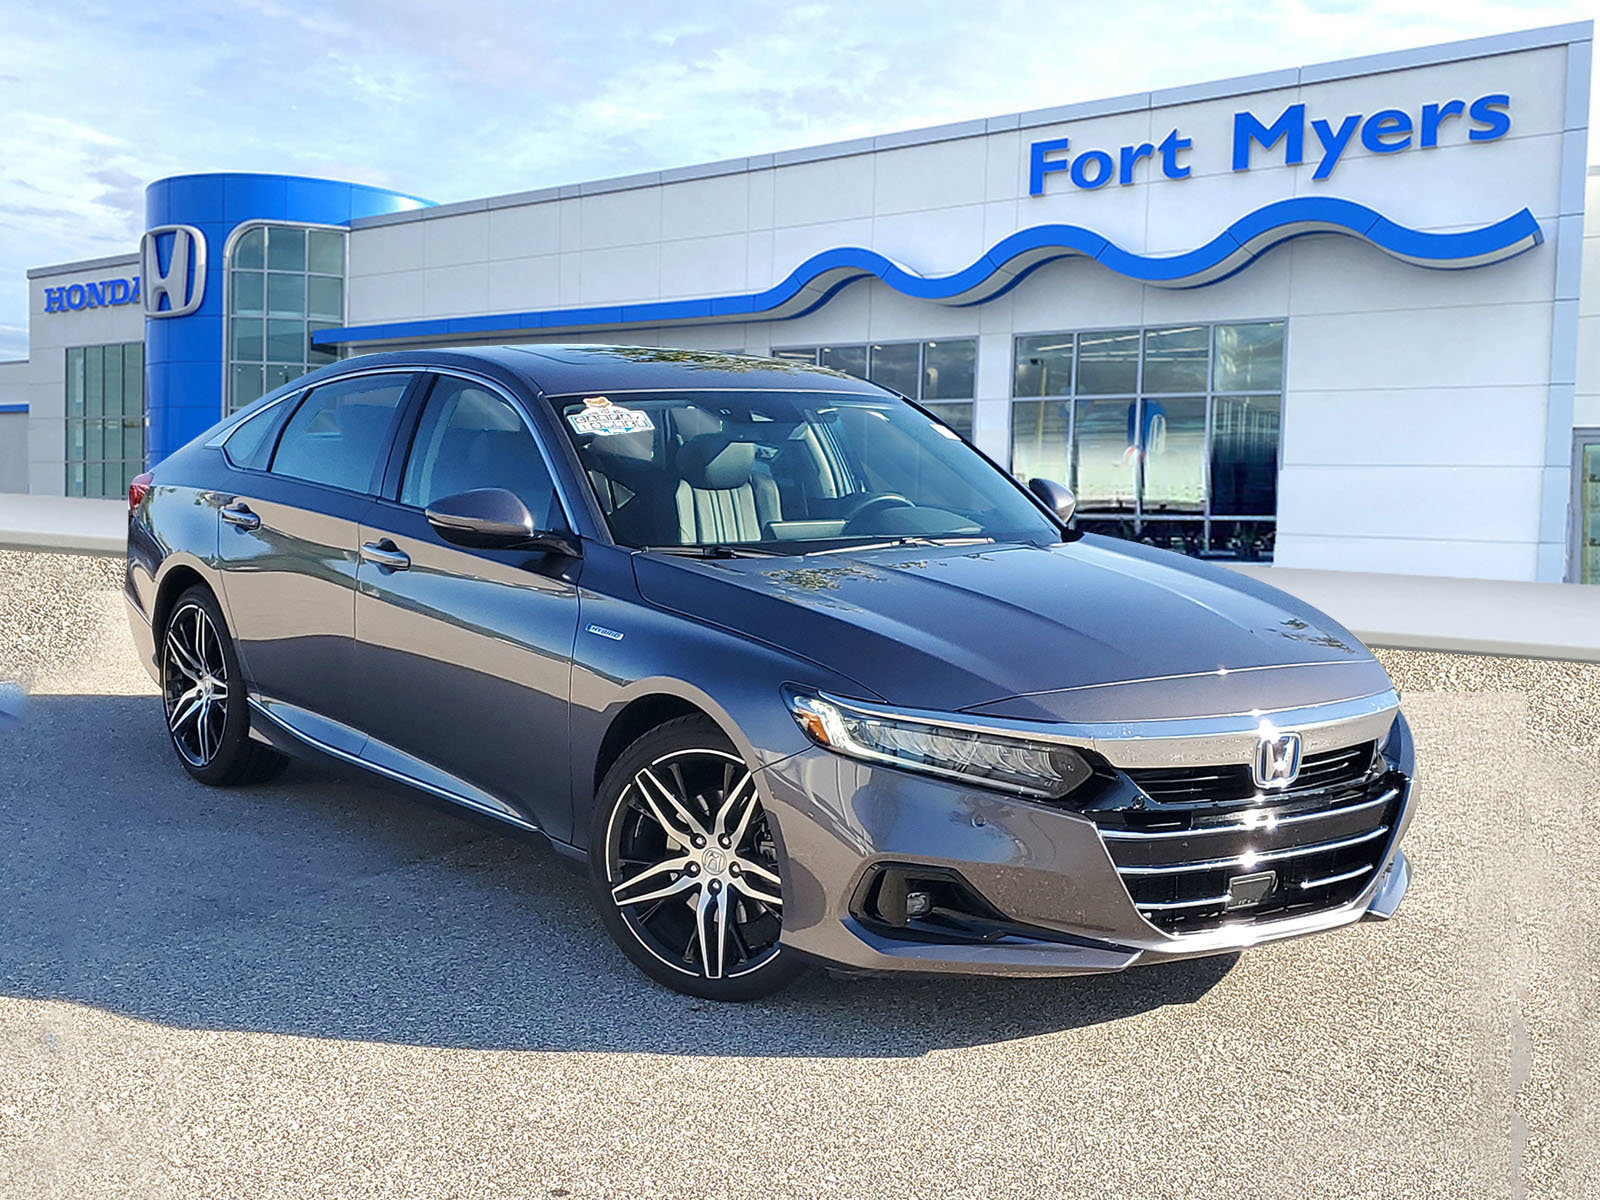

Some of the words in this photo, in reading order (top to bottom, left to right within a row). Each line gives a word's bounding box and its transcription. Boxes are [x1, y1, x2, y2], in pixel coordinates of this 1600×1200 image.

[1029, 128, 1192, 196] Fort
[1231, 94, 1511, 180] Myers
[591, 626, 622, 639] HYBRID
